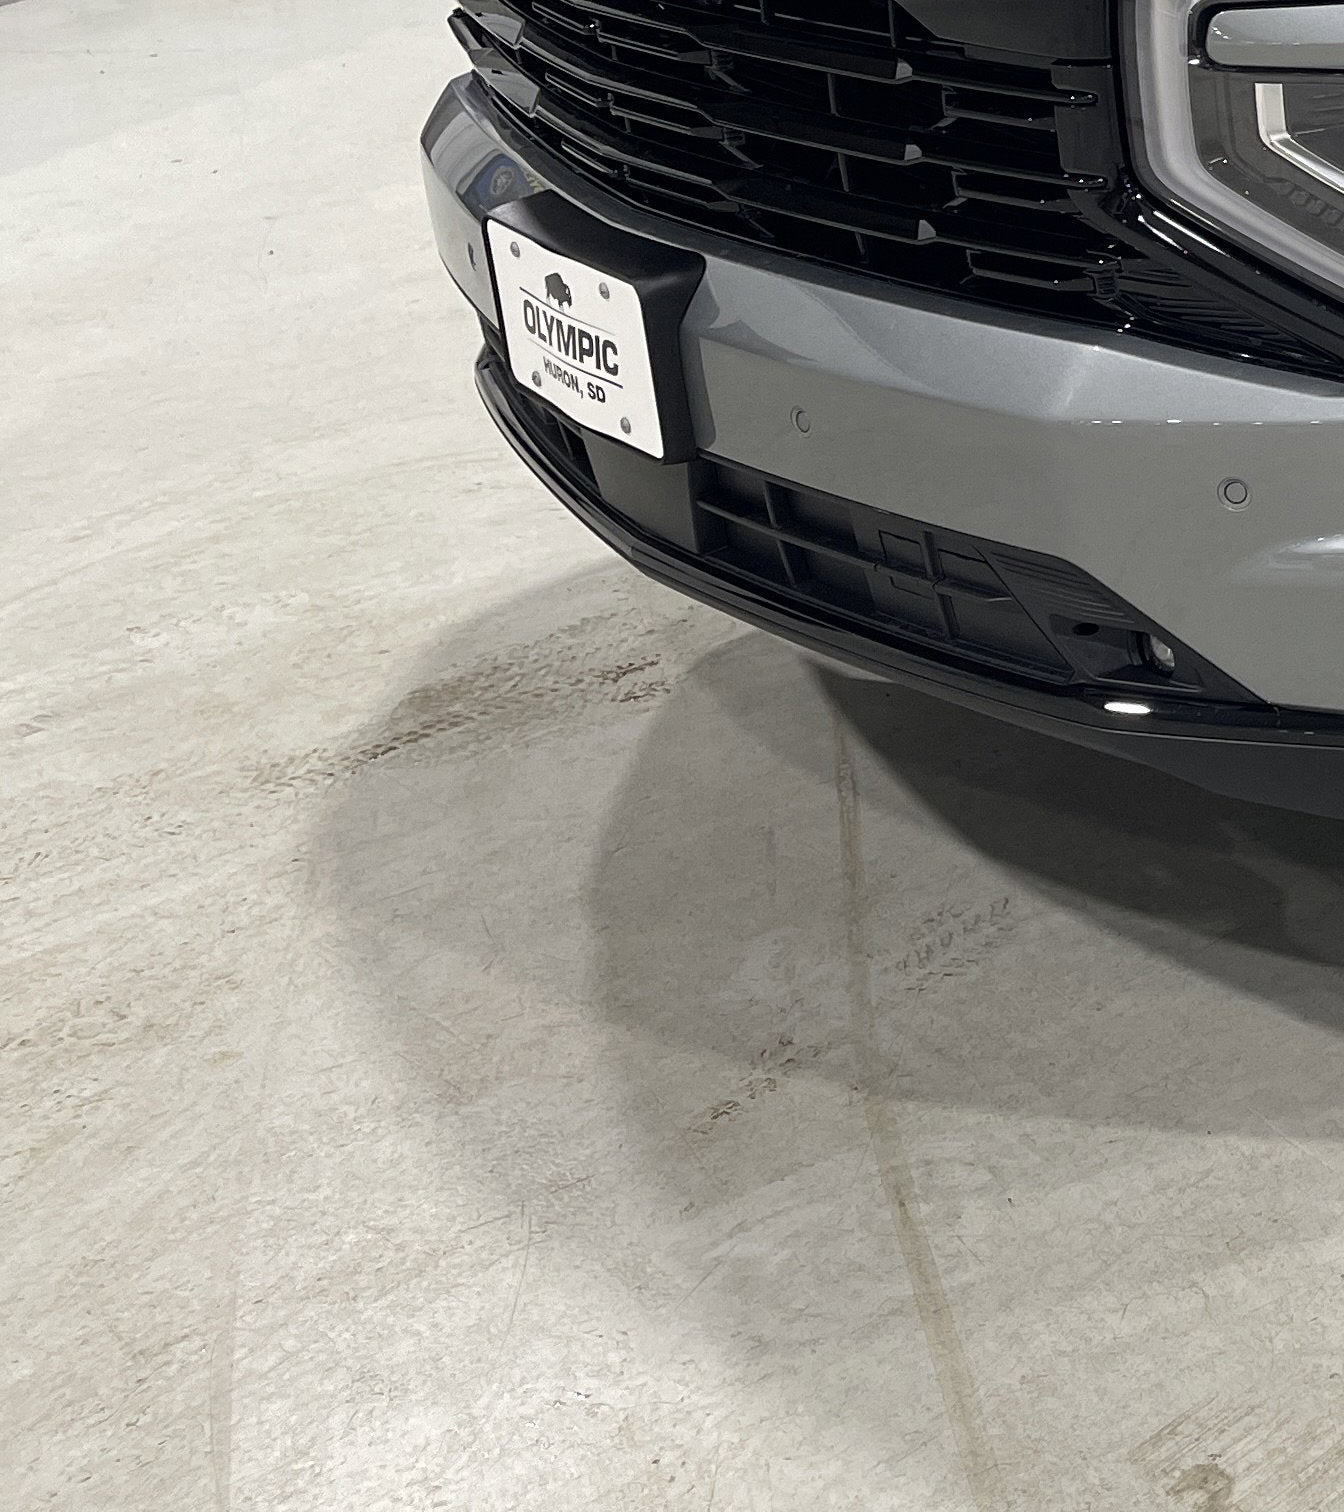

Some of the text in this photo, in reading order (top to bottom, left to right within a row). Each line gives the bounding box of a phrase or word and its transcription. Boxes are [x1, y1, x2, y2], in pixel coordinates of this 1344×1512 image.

[523, 299, 619, 377] OLYMPIC
[543, 355, 606, 403] HURON, SD
